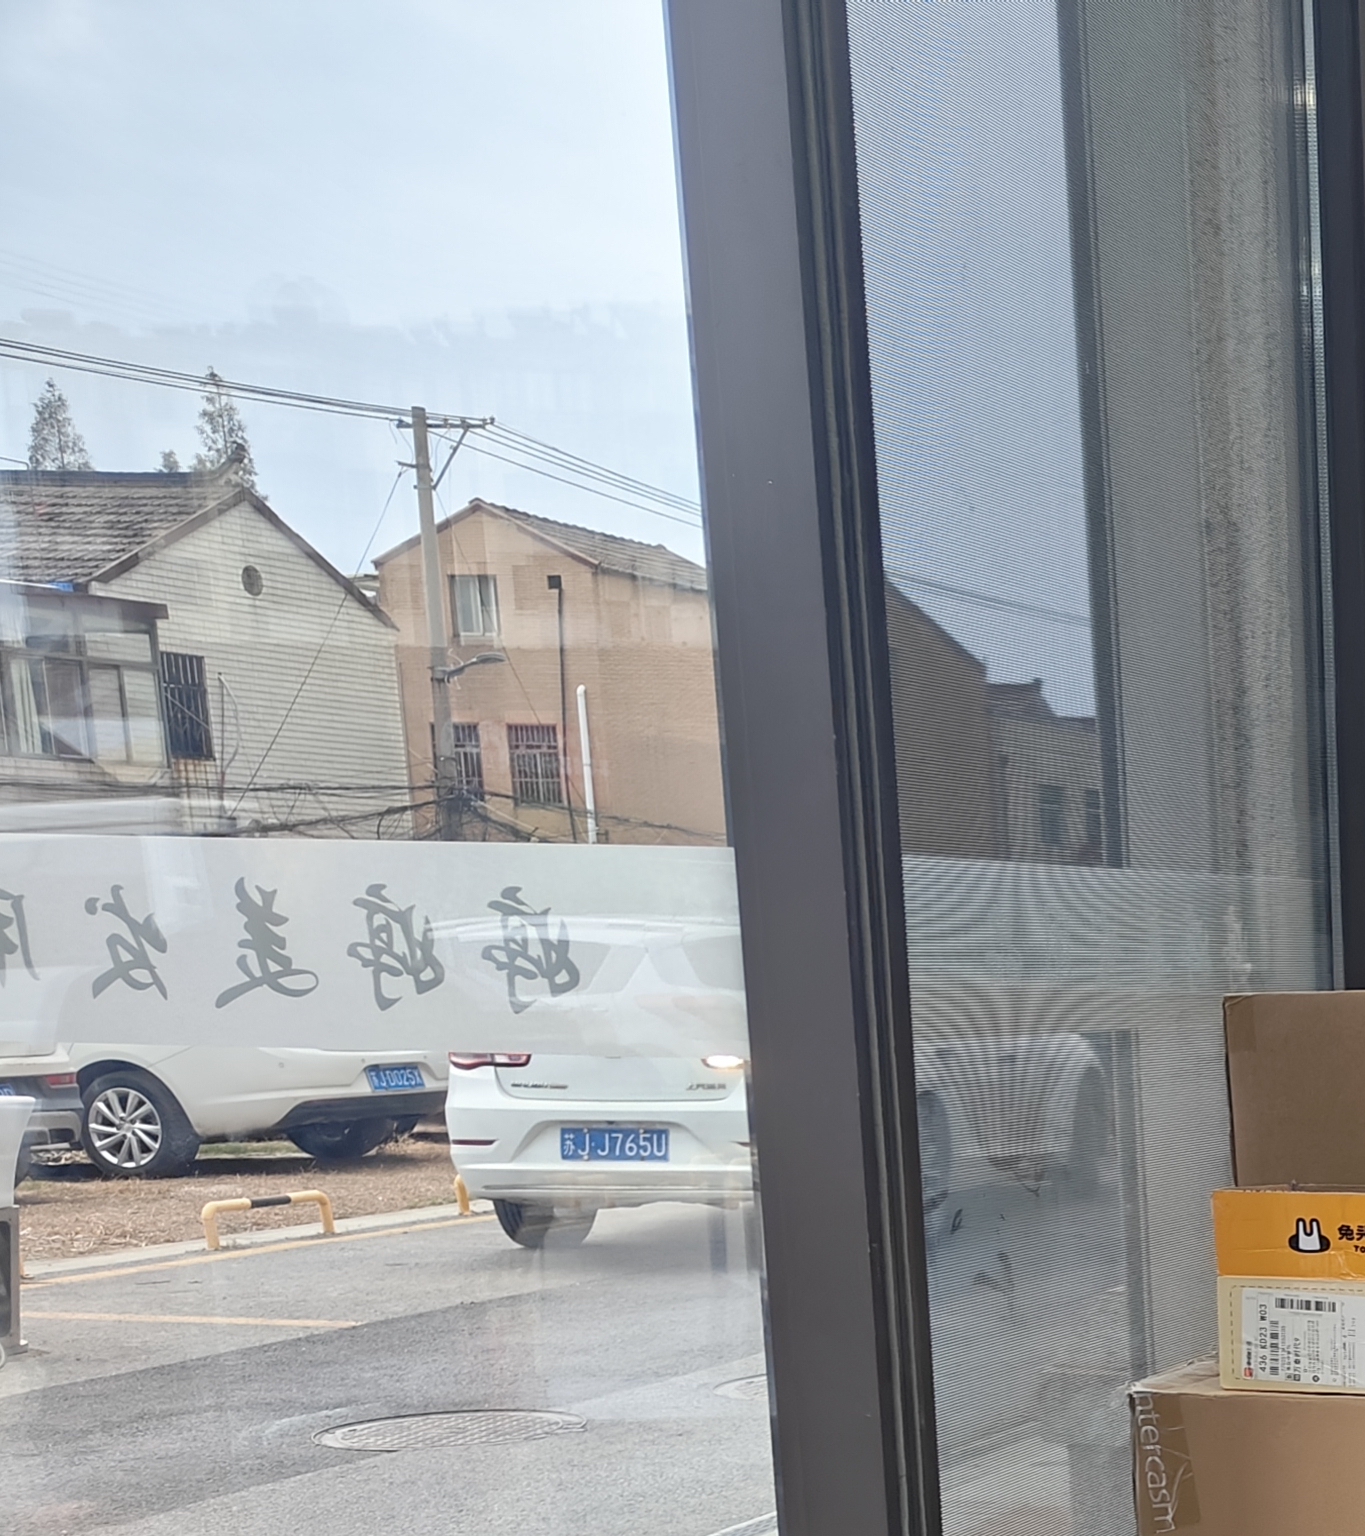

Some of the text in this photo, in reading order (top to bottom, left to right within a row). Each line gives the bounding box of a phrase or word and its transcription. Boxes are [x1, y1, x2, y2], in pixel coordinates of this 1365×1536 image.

[1258, 1303, 1268, 1373] 436 KD23 W03
